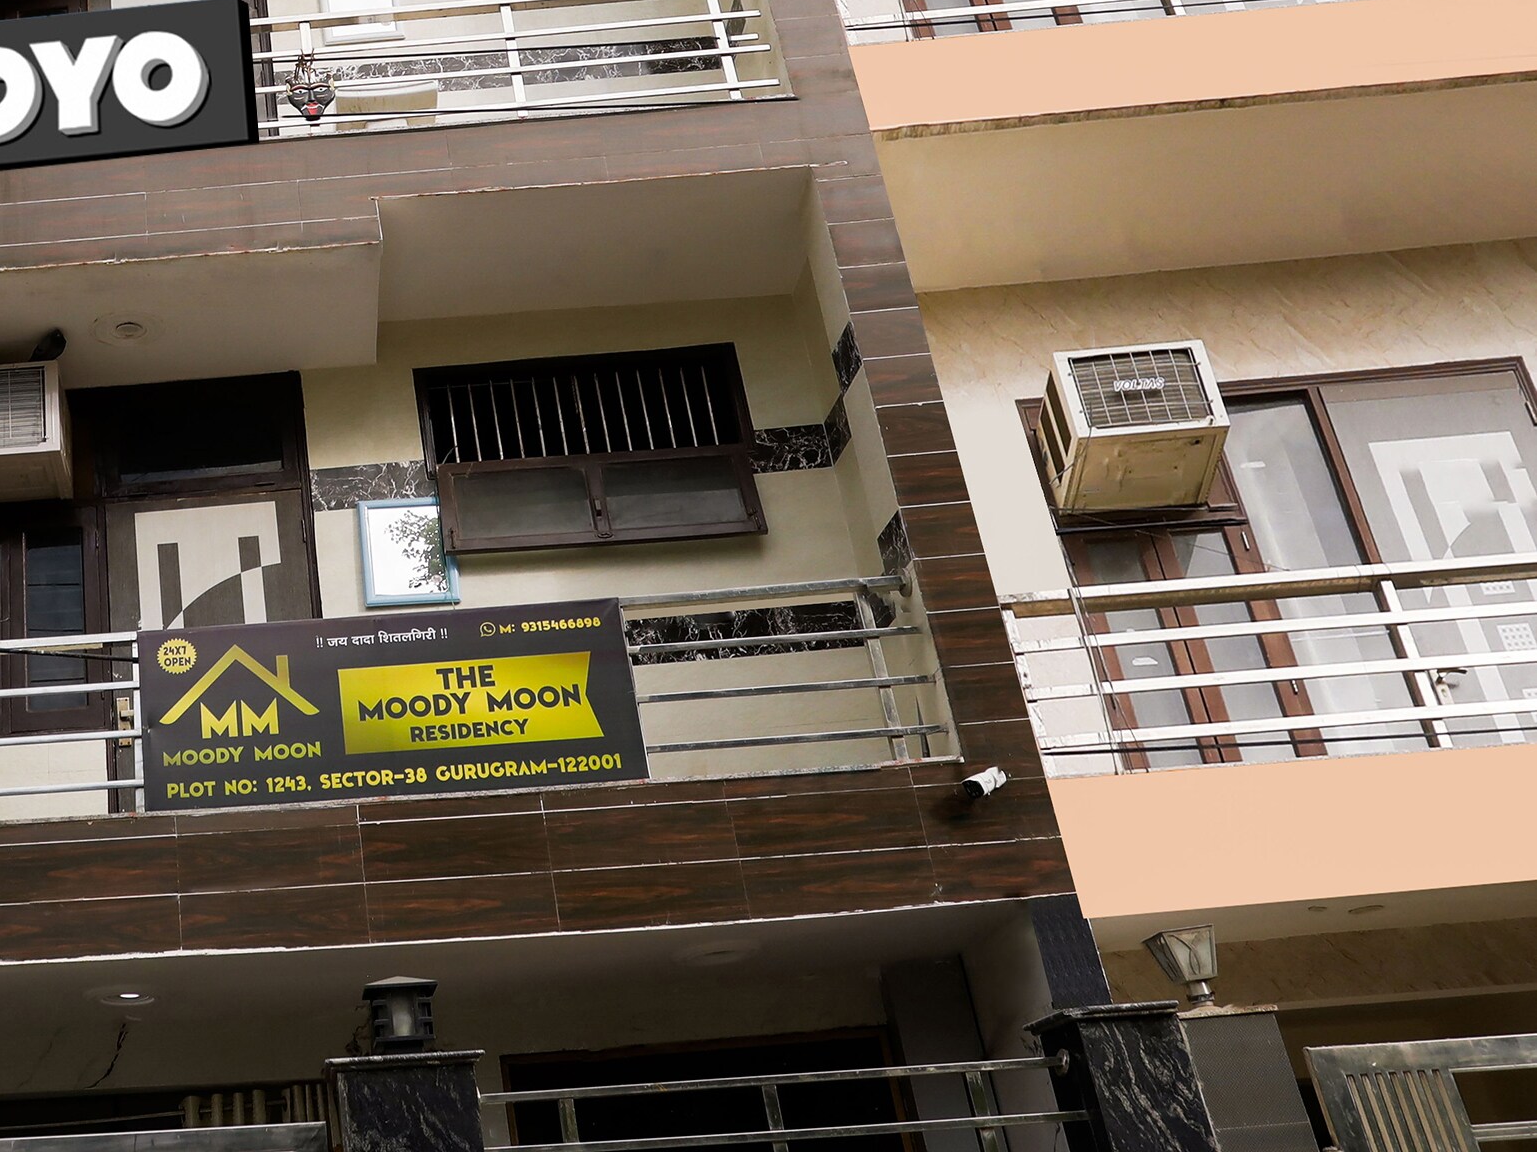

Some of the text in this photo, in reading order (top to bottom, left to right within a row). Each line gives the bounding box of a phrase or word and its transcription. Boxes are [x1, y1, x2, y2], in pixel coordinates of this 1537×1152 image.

[1113, 377, 1165, 391] VOLTAS
[499, 616, 601, 634] M: 9315466898
[327, 636, 348, 648] जय
[351, 634, 375, 646] दादा
[378, 628, 436, 645] शितलगिरी
[163, 645, 187, 657] 24X7
[163, 656, 191, 667] OPEN
[436, 664, 496, 690] THE
[358, 683, 582, 722] MOODY MOON
[200, 697, 279, 739] MM
[410, 718, 529, 742] RESIDENCY
[163, 741, 321, 767] MOODY MOON
[166, 781, 215, 799] PLOT
[224, 778, 258, 796] NO:
[319, 768, 427, 788] SECTOR-38
[435, 752, 622, 782] GURUGRAM-122001
